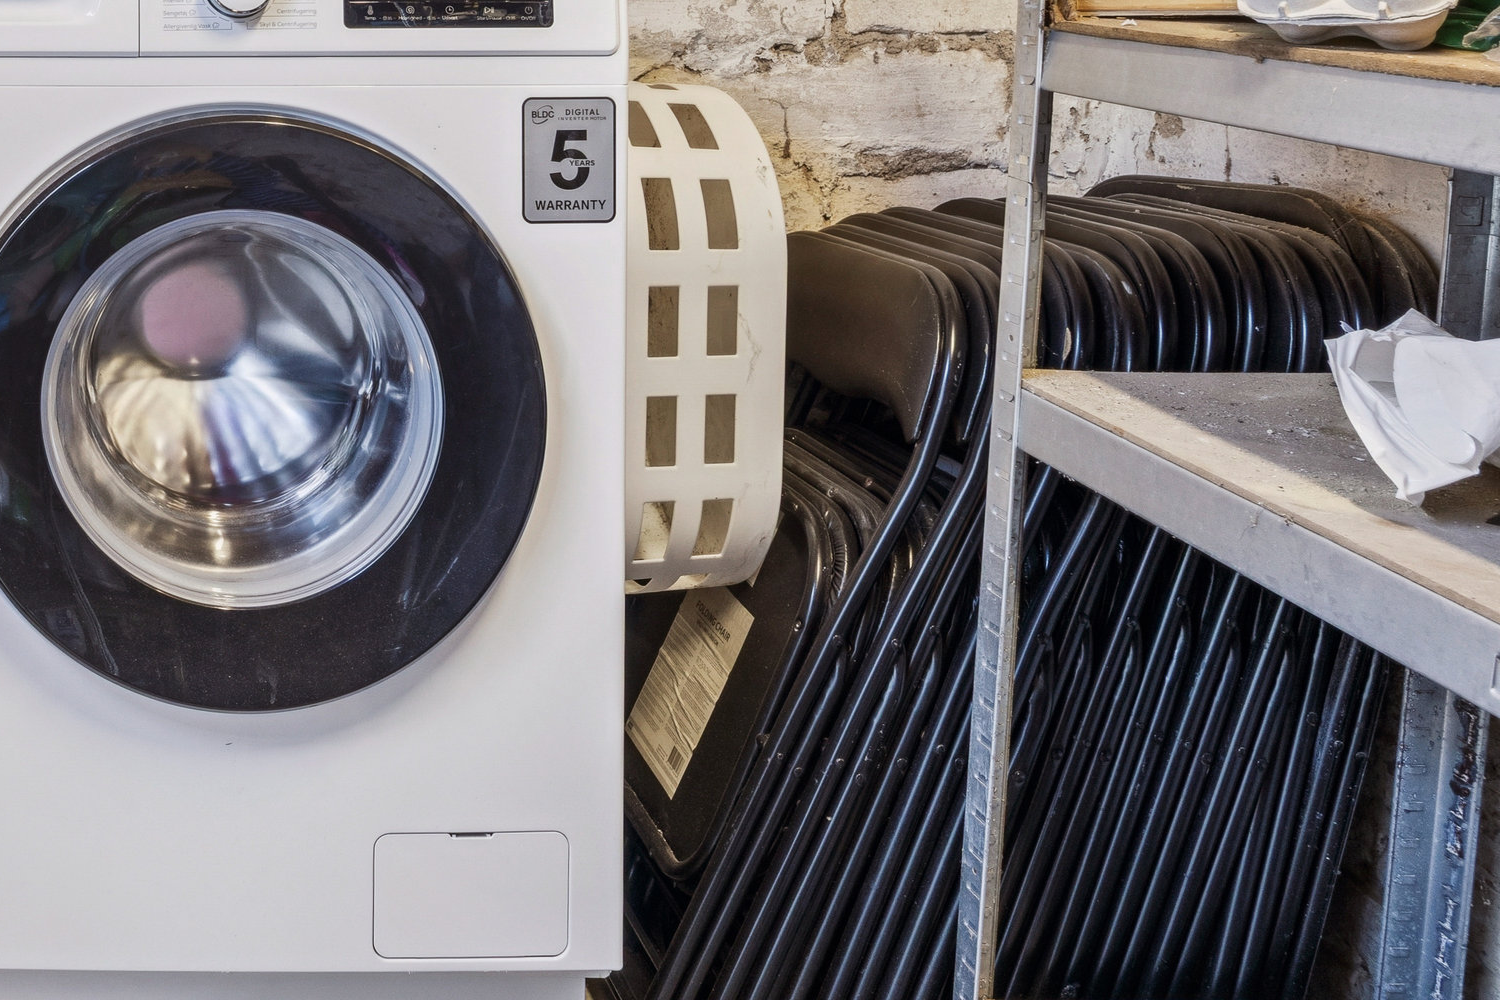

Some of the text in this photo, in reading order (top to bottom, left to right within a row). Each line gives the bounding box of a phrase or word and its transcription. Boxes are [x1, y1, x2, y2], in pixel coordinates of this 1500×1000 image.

[531, 110, 555, 119] BLDC
[565, 108, 600, 116] DIGITAL
[549, 129, 590, 191] 5
[569, 159, 596, 167] YEARS
[535, 199, 607, 211] WARRANTY
